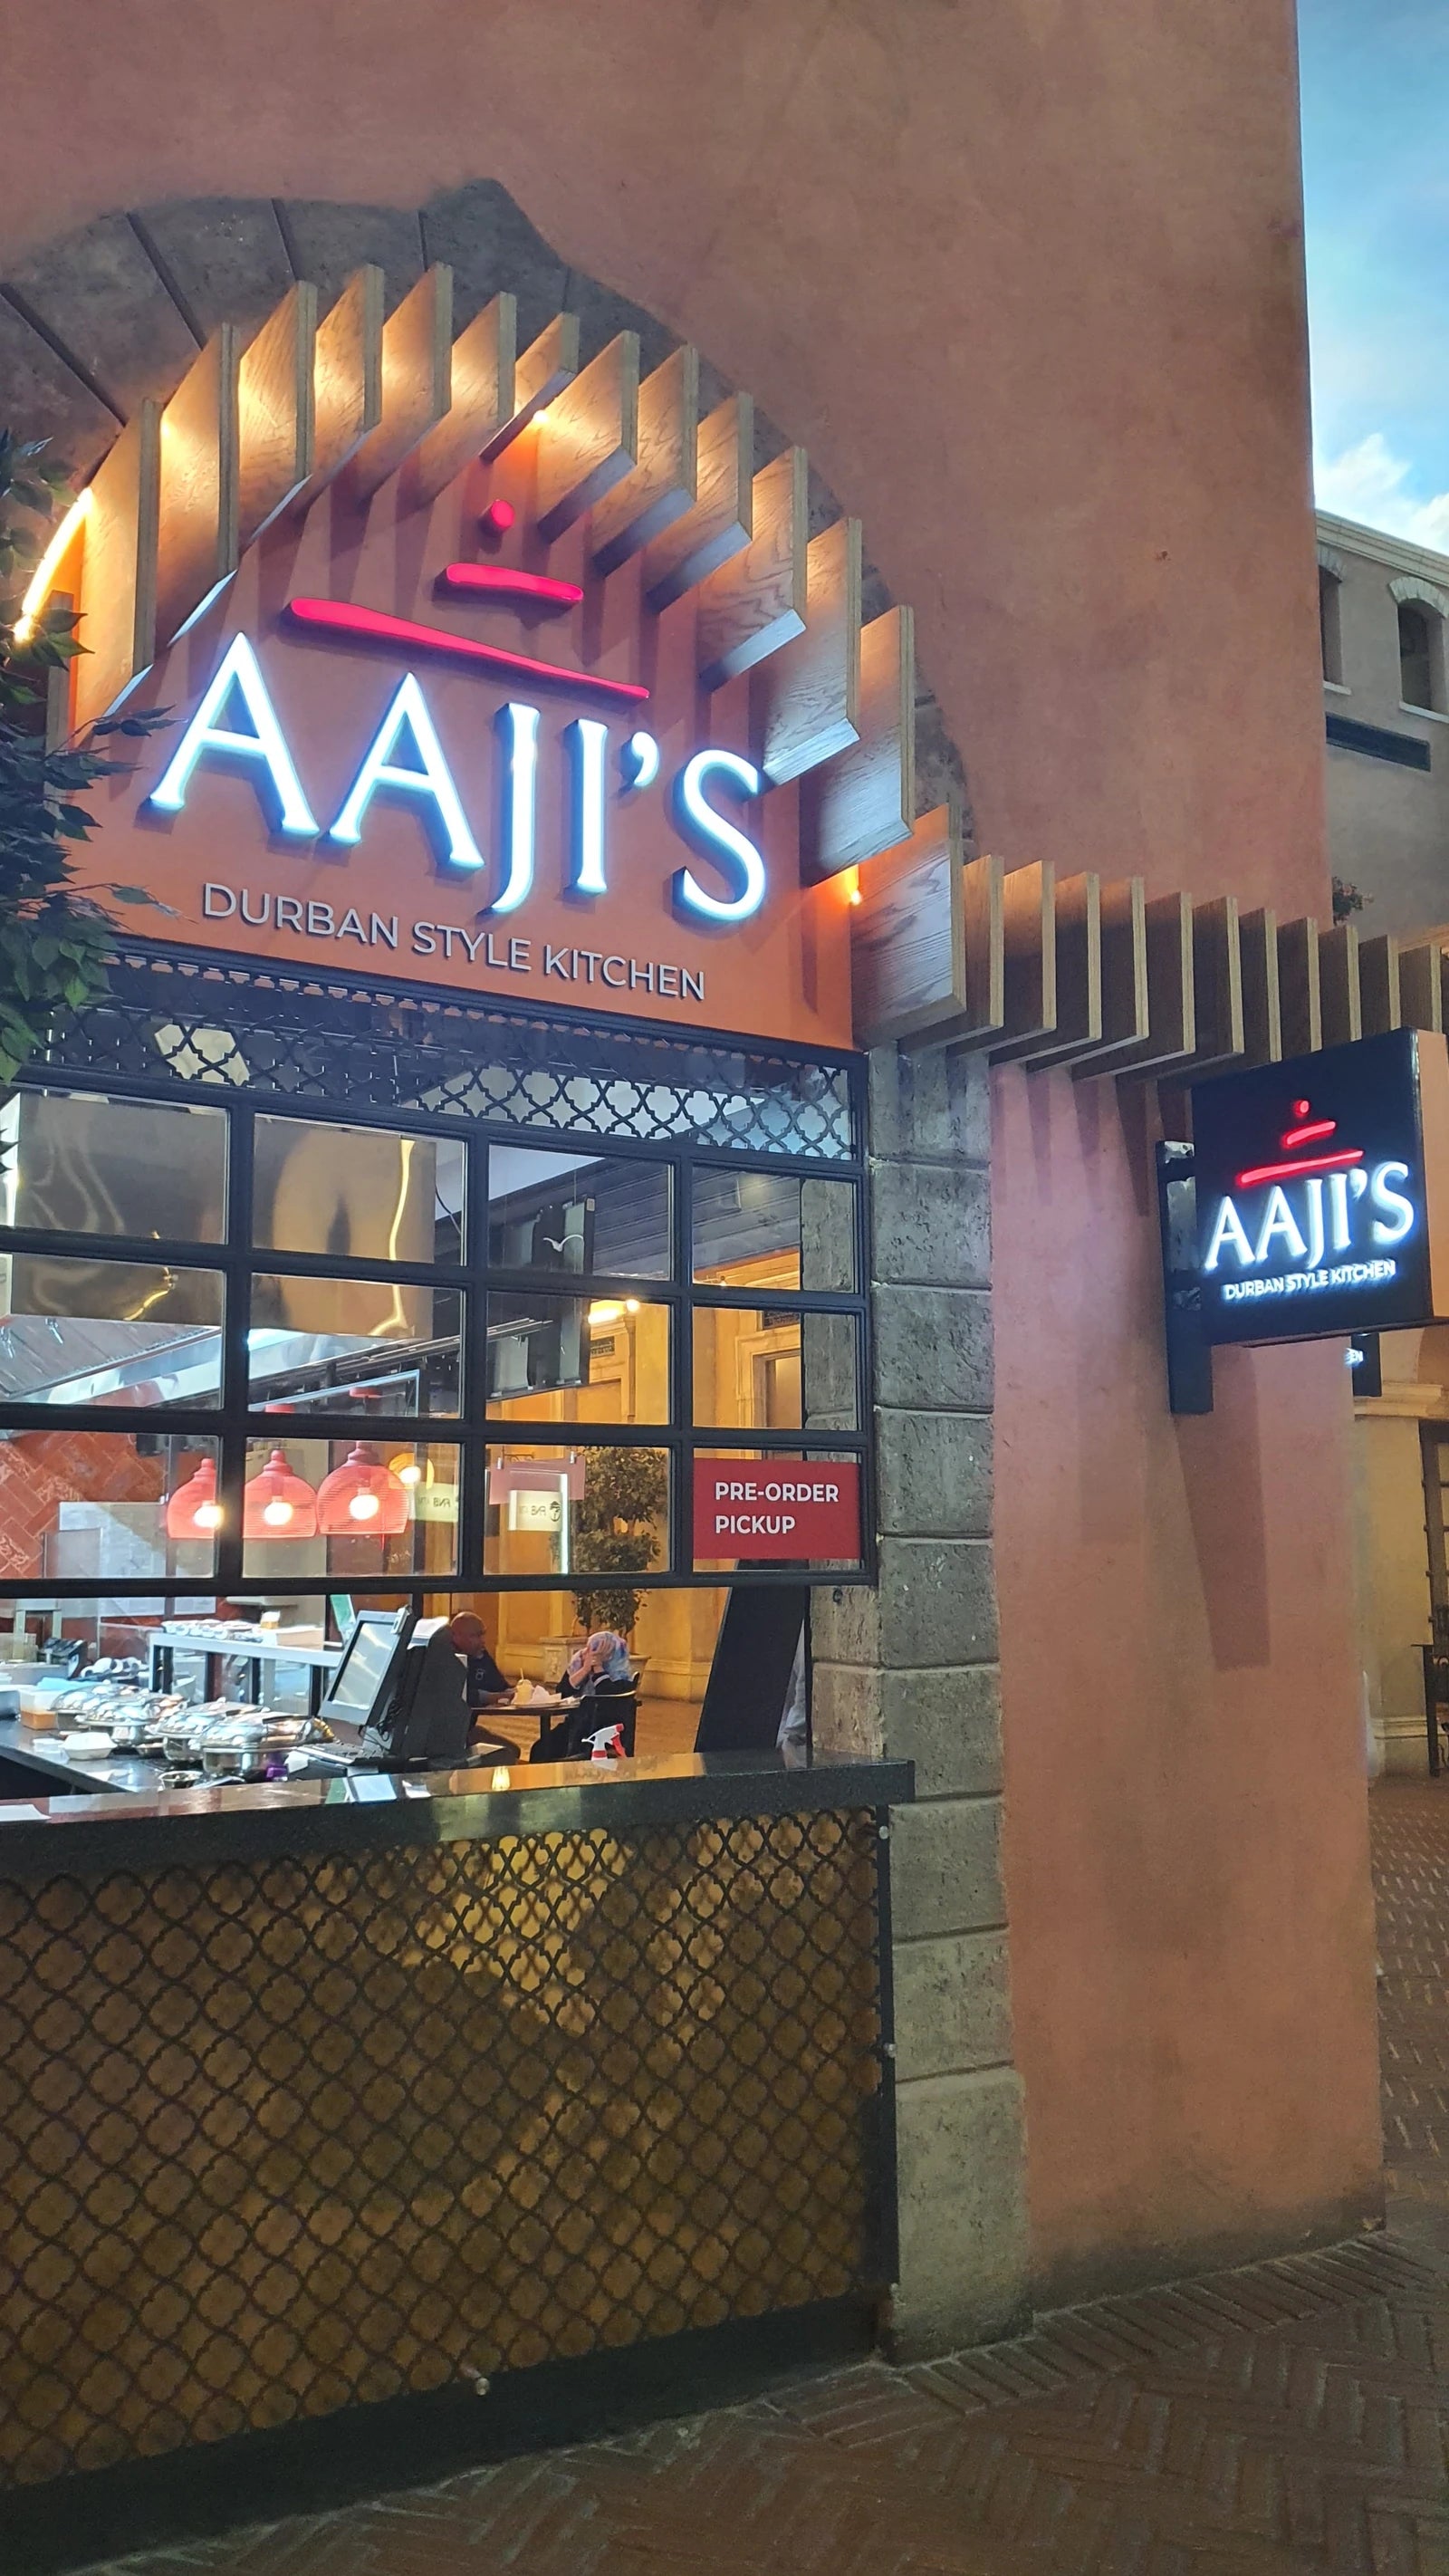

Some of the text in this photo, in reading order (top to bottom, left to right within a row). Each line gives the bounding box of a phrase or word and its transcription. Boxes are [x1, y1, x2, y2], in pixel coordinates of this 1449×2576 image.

[149, 631, 768, 920] AAJI'S
[203, 881, 705, 1000] DURBAN STYLE KITCHEN
[1204, 1160, 1415, 1272] AAJI'S
[1223, 1258, 1396, 1301] DURBAN STYLE KITCHEN
[715, 1481, 840, 1503] PRE-ORDER
[715, 1514, 796, 1534] PICKUP
